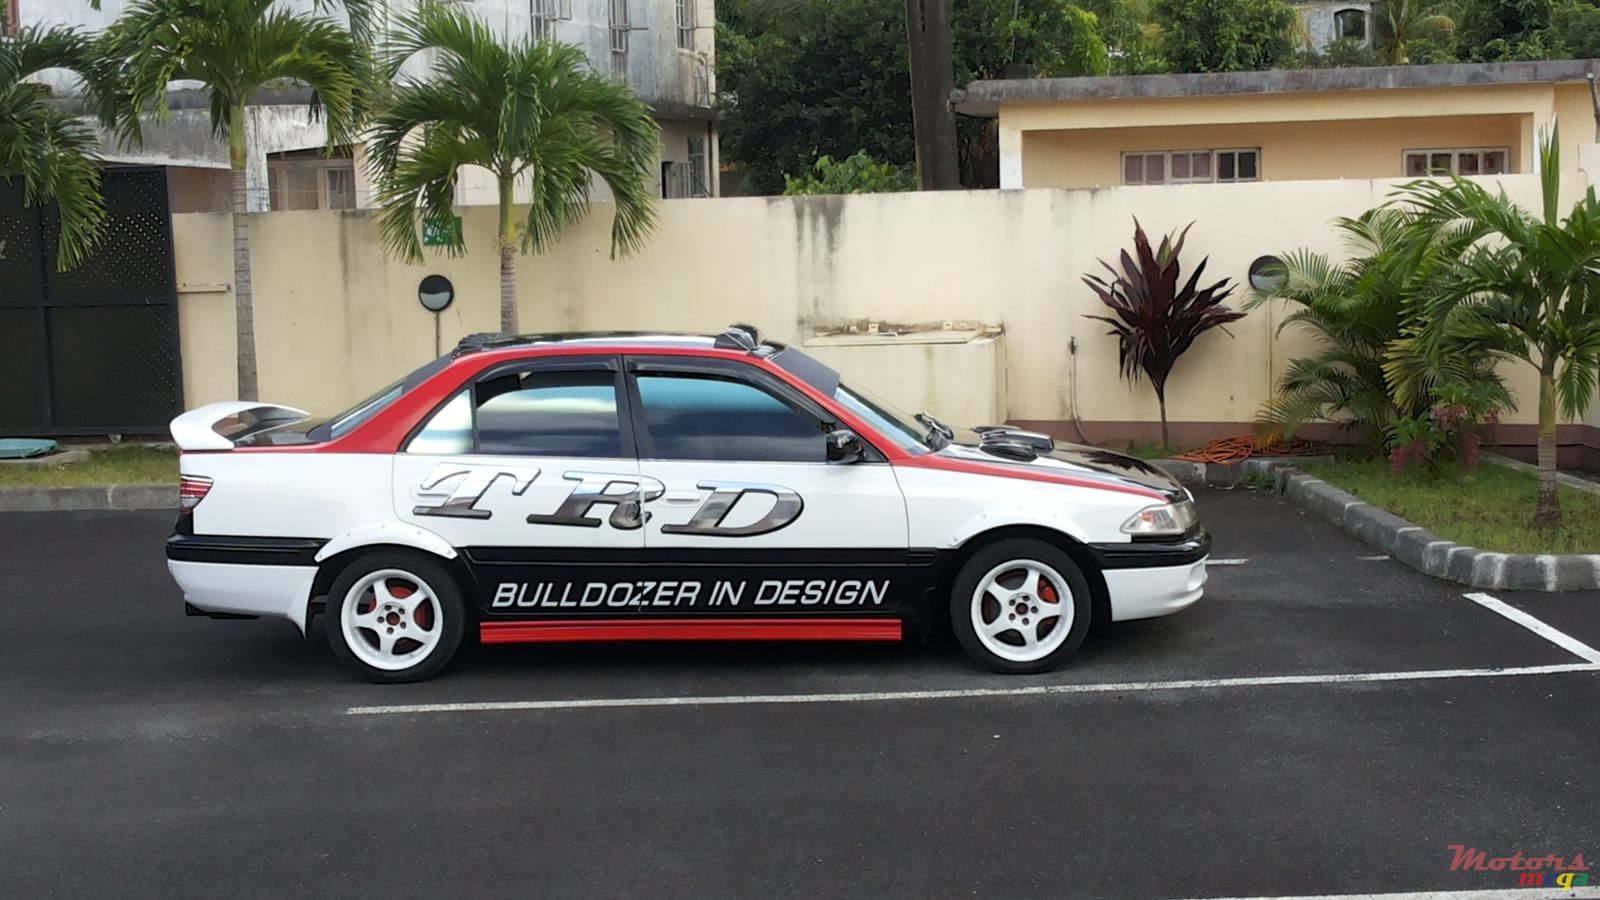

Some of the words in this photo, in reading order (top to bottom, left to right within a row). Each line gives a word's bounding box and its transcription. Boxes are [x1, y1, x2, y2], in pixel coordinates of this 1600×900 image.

[412, 462, 805, 538] TRD
[491, 581, 702, 607] BULLDOZER
[708, 580, 747, 606] IN
[753, 579, 890, 605] DESIGN
